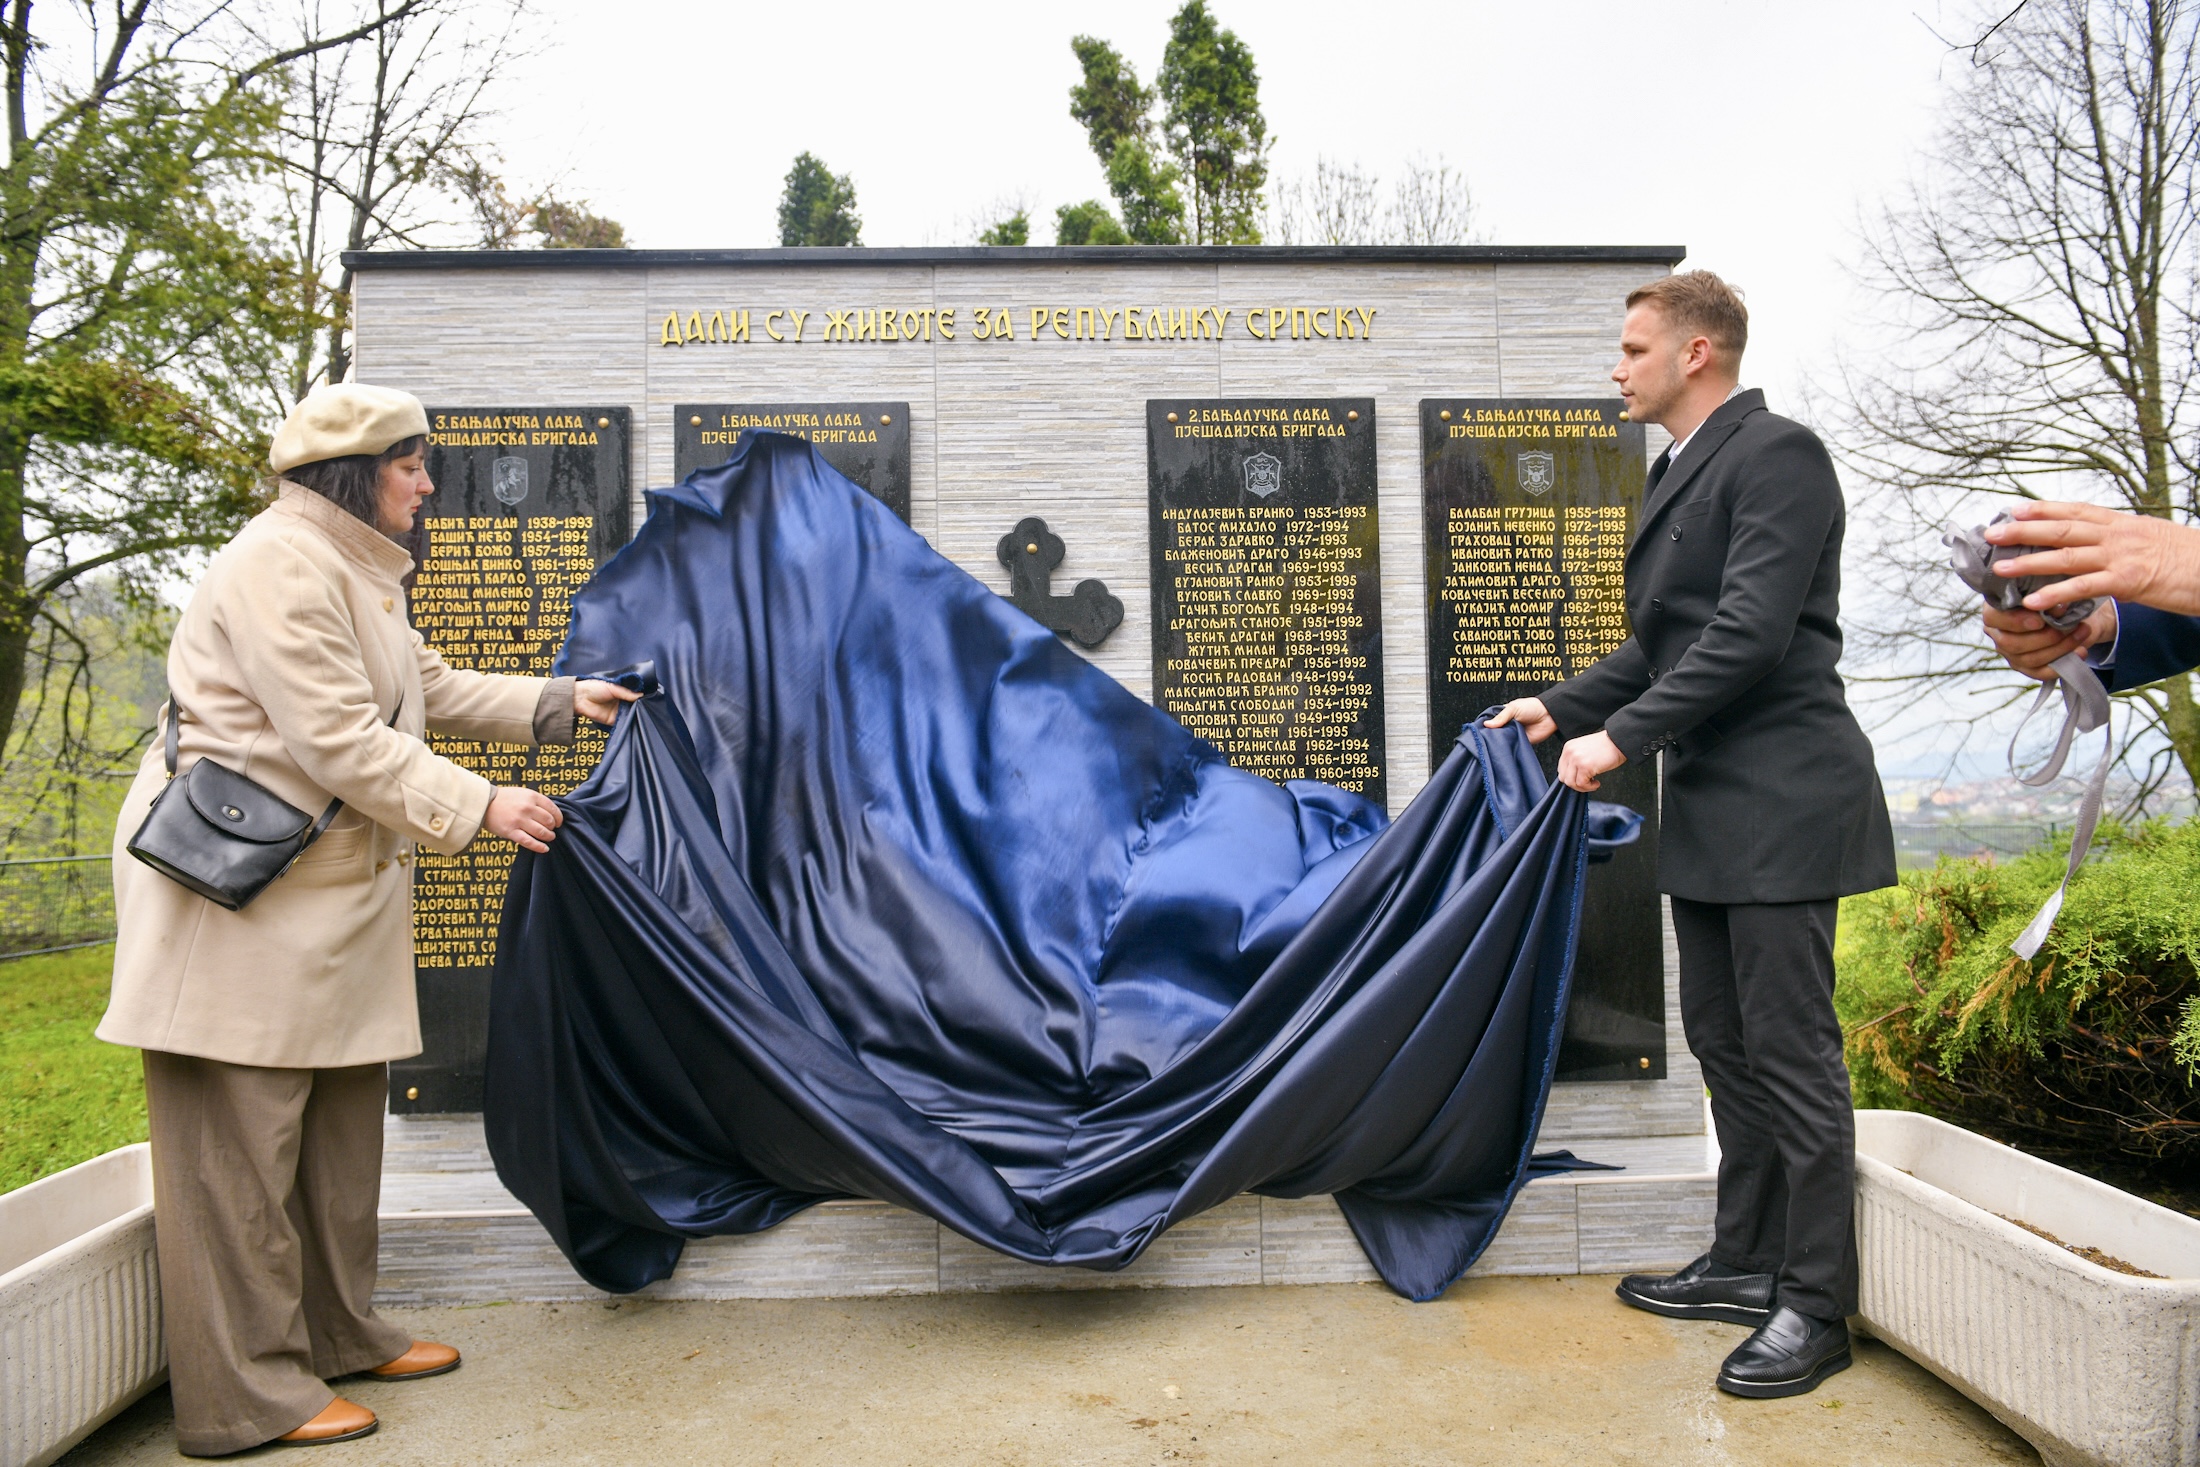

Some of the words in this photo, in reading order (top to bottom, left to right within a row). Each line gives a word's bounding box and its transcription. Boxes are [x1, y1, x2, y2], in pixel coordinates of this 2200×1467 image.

[660, 310, 750, 345] ДАЛИ
[765, 310, 807, 341] СУ
[824, 308, 954, 340] ЖИВОТЕ
[972, 307, 1014, 339] ЗА
[1030, 306, 1230, 339] РЕПУБЛИКУ
[1246, 306, 1376, 339] СРПСКУ
[722, 414, 819, 428] 1.БАЊАЛУЧКА
[824, 414, 861, 426] ЛАКА
[1189, 408, 1289, 422] 2.БАЊАЛУЧКА
[1293, 408, 1330, 421] ЛАКА
[1462, 408, 1562, 422] 4.БАЊАЛУЧКА
[1565, 409, 1602, 422] ЛАКА
[435, 415, 540, 430] 3.БАЊАЛУЧКА
[544, 416, 583, 428] ЛАКА
[811, 430, 877, 443] БРИГАДА
[1175, 425, 1277, 438] ПЈЕШАДИЈСКА
[1282, 424, 1346, 437] БРИГАДА
[1450, 424, 1550, 438] ПЈЕШАДИЈСКА
[1554, 424, 1617, 438] БРИГАДА
[425, 432, 527, 446] ЈЕШАДИЈСКА
[532, 432, 598, 445] БРИГАДА
[1162, 508, 1244, 519] АНДУЛАЈЕВИЋ
[1250, 507, 1294, 518] БРАНКО
[1450, 507, 1501, 519] БАЛАБАН
[1504, 506, 1556, 519] ГРУЈИЦА
[424, 517, 466, 530] БАБИЋ
[469, 517, 518, 530] БОГДАН
[1177, 522, 1214, 533] БАТОС
[1220, 521, 1276, 532] МИХАЈЛО
[1448, 521, 1500, 533] БОЈАНИЋ
[1504, 520, 1556, 532] НЕВЕНКО
[430, 531, 475, 544] БАШИЋ
[478, 530, 512, 542] НЕЂО
[1178, 536, 1215, 546] БЕРАК
[1221, 535, 1274, 546] ЗДРАВКО
[1451, 535, 1512, 546] ГРАХОВАЦ
[1516, 534, 1554, 546] ГОРАН
[430, 545, 471, 558] БЕРИЋ
[475, 544, 513, 557] БОЖО
[1165, 549, 1246, 560] БЛАЖЕНОВИЋ
[1251, 548, 1288, 560] ДРАГО
[1452, 548, 1512, 559] ИВАНОВИЋ
[1516, 547, 1553, 558] РАТКО
[423, 558, 479, 572] БОШЊАК
[482, 558, 523, 571] ВИНКО
[1185, 562, 1222, 574] ВЕСИЋ
[1228, 562, 1272, 573] ДРАГАН
[1454, 562, 1511, 572] ЈАНКОВИЋ
[1515, 561, 1552, 572] НЕНАД
[416, 572, 481, 586] ВАЛЕНТИЋ
[484, 572, 526, 584] КАРЛО
[1176, 576, 1242, 588] ВУЈАНОВИЋ
[1246, 576, 1284, 587] РАНКО
[1446, 575, 1517, 586] ЈАЋИМОВИЋ
[1522, 575, 1561, 586] ДРАГО
[411, 587, 469, 600] ВРХОВАЦ
[472, 586, 534, 599] МИЛЕНКО
[1178, 590, 1231, 601] ВУКОВИЋ
[1236, 590, 1282, 601] СЛАВКО
[1441, 589, 1509, 600] КОВАЧЕВИЋ
[1513, 588, 1566, 600] ВЕСЕЛКО
[412, 600, 482, 614] ДРАГОЉИЋ
[485, 600, 530, 612] МИРКО
[1180, 604, 1218, 614] ГАЧИЋ
[1222, 603, 1280, 615] БОГОЉУБ
[1455, 602, 1506, 613] ЛУКАЈИЋ
[1510, 602, 1554, 612] МОМИР
[415, 614, 484, 628] ДРАГУШИЋ
[488, 614, 528, 626] ГОРАН
[1171, 617, 1237, 629] ДРАГОЉИЋ
[1241, 616, 1292, 628] СТАНОЈЕ
[1459, 616, 1500, 627] МАРИЋ
[1504, 616, 1550, 628] БОГДАН
[430, 628, 470, 642] ДРВАР
[474, 629, 514, 641] НЕНАД
[1185, 631, 1226, 643] ЂЕКИЋ
[1230, 630, 1275, 642] ДРАГАН
[1454, 630, 1520, 641] САВАНОВИЋ
[1526, 629, 1555, 640] ЈОВО
[483, 642, 542, 655] БУДИМИР
[1189, 645, 1230, 656] ЖУТИЋ
[1234, 645, 1275, 655] МИЛАН
[1456, 643, 1507, 654] СМИЉИЋ
[1511, 643, 1556, 654] СТАНКО
[478, 656, 520, 669] ДРАГО
[1168, 658, 1237, 670] КОВАЧЕВИЋ
[1241, 657, 1294, 669] ПРЕДРАГ
[1450, 657, 1502, 668] РАЂЕВИЋ
[1507, 656, 1562, 667] МАРИНКО
[1183, 672, 1222, 683] КОСИЋ
[1226, 672, 1281, 683] РАДОВАН
[1447, 670, 1502, 682] ТОЛИМИР
[1506, 670, 1565, 681] МИЛОРАД
[1164, 685, 1250, 698] МАКСИМОВИЋ
[1254, 685, 1298, 696] БРАНКО
[1168, 700, 1226, 712] ПИЉАГИЋ
[1230, 699, 1295, 710] СЛОБОДАН
[1182, 714, 1237, 725] ПОПОВИЋ
[1242, 714, 1284, 725] БОШКО
[1194, 728, 1231, 738] ПРИЦА
[1237, 727, 1278, 738] ОГЊЕН
[1229, 740, 1296, 752] БРАНИСЛАВ
[492, 755, 527, 768] БОРО
[1232, 754, 1295, 766] ДРАЖЕНКО
[424, 870, 471, 882] СТРИКА
[418, 955, 452, 968] ШЕВА
